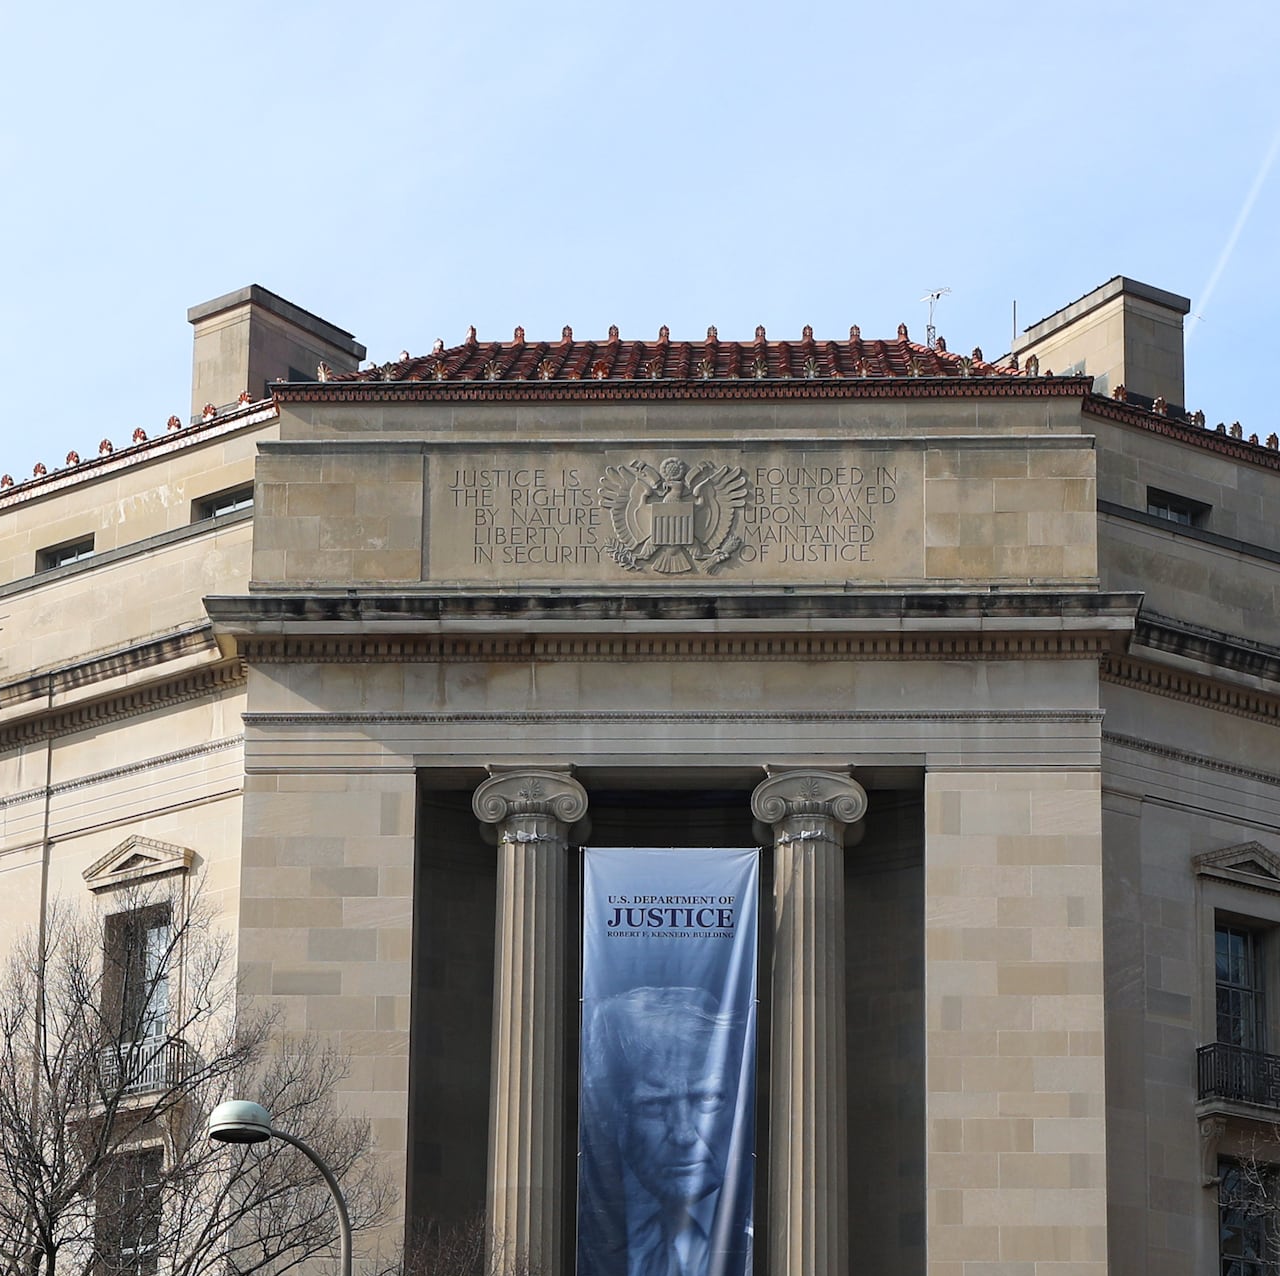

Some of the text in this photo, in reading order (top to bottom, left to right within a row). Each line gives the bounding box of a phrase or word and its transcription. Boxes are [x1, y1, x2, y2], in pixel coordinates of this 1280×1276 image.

[448, 466, 898, 488] JUSTICE IS FOUNDED IN
[450, 486, 896, 507] THE RIGHTS BESTOWED
[474, 506, 876, 526] BY NATURE UPON MAN.
[474, 525, 875, 545] LIBERTY IS MAINTAINED
[474, 544, 876, 564] IN SECURITY OF JUSTICE.
[608, 895, 735, 905] U.S. DEPARTMENT OF
[607, 907, 735, 928] JUSTICE
[693, 931, 734, 939] BUILDING
